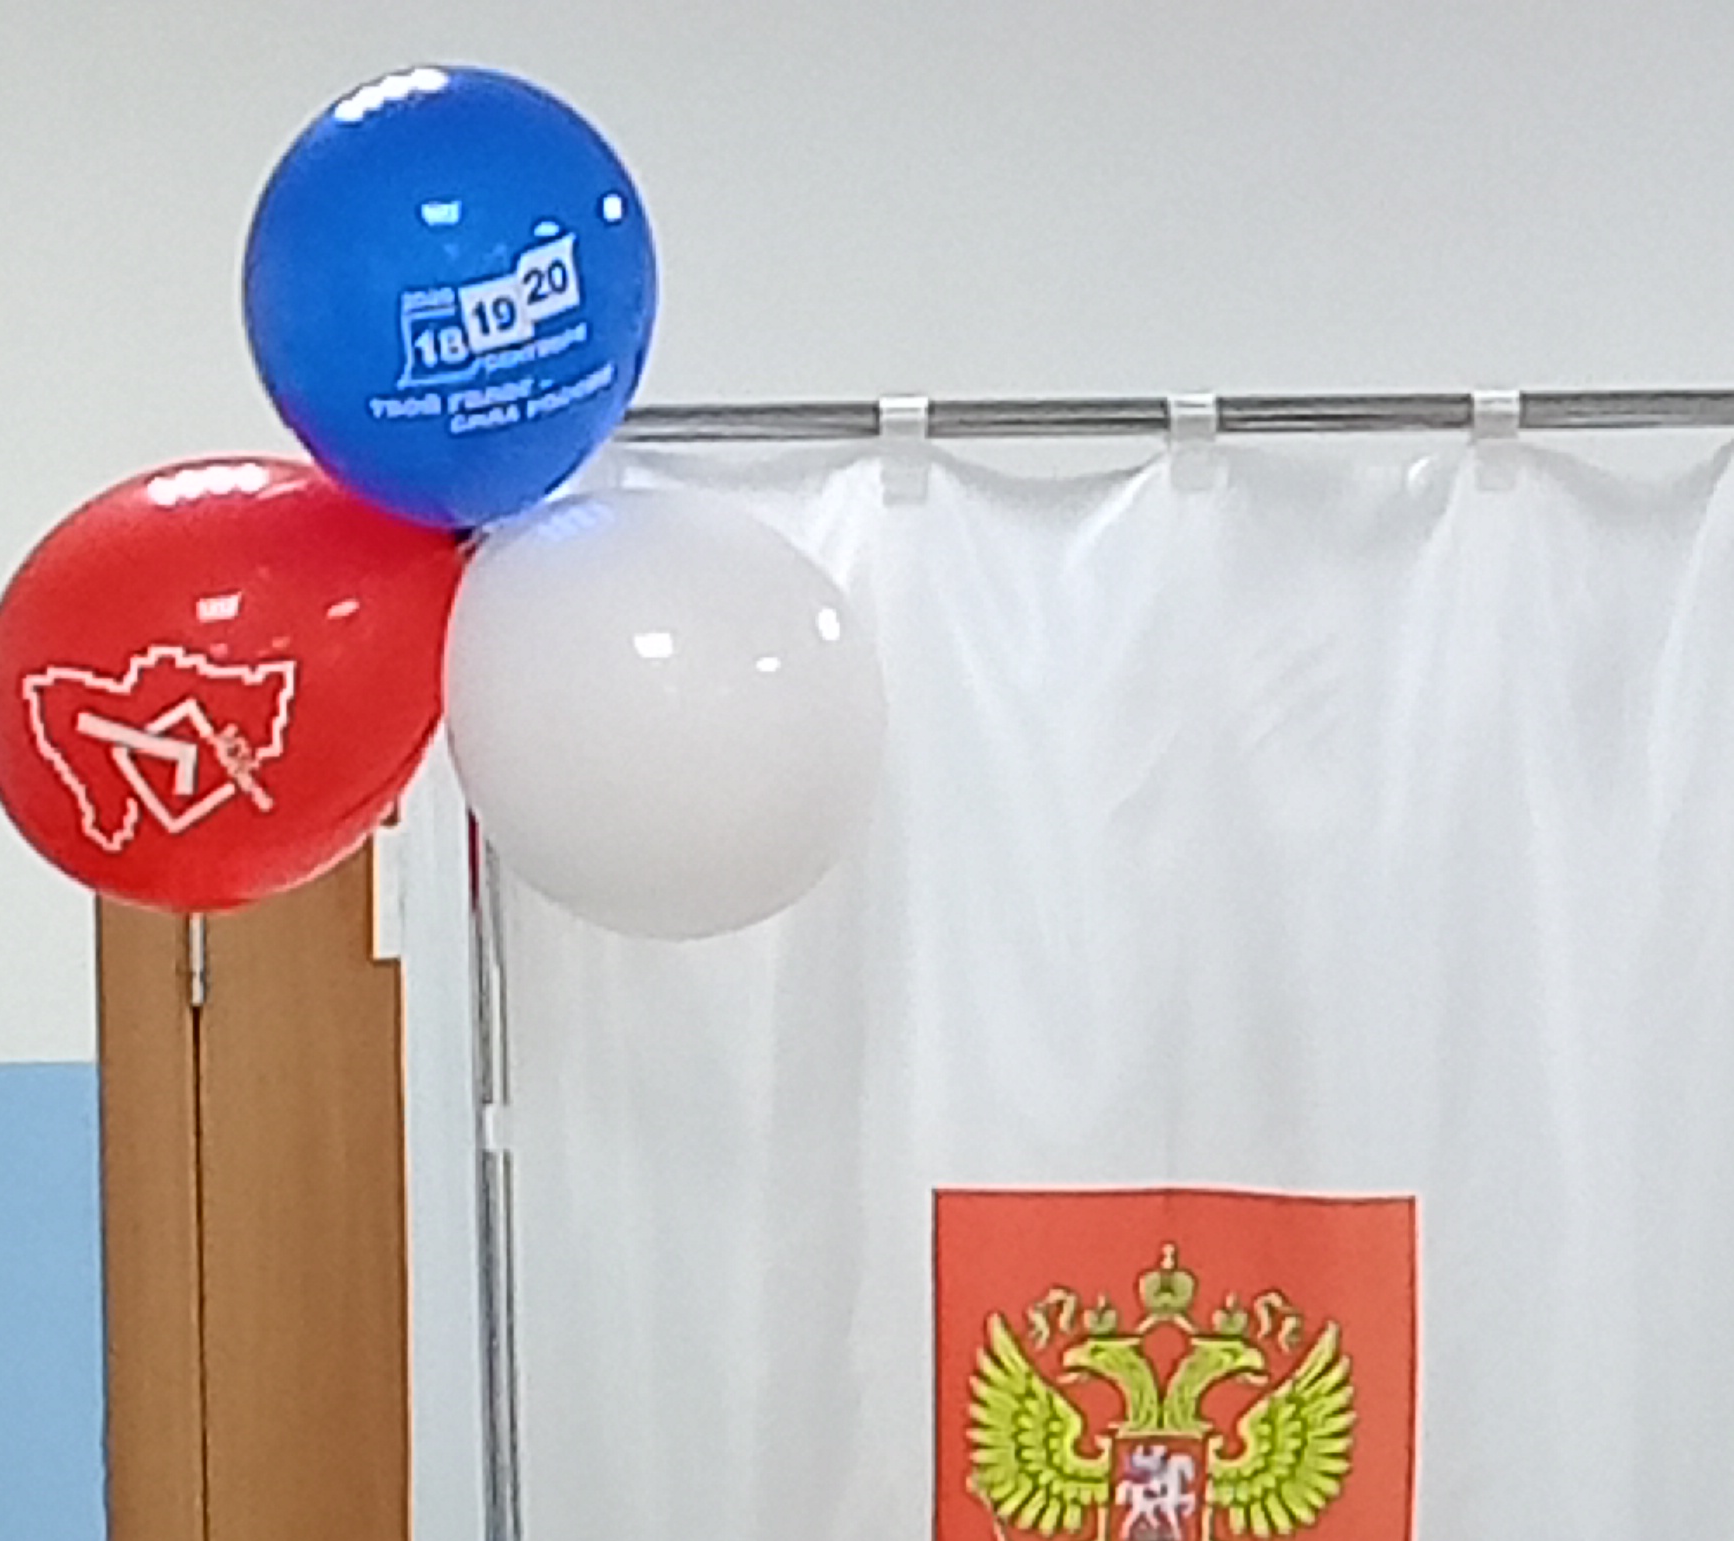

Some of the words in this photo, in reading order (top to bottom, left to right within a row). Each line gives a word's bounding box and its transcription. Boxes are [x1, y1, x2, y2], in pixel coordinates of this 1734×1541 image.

[414, 326, 469, 368] 18
[471, 295, 517, 337] 19
[522, 258, 568, 306] 20
